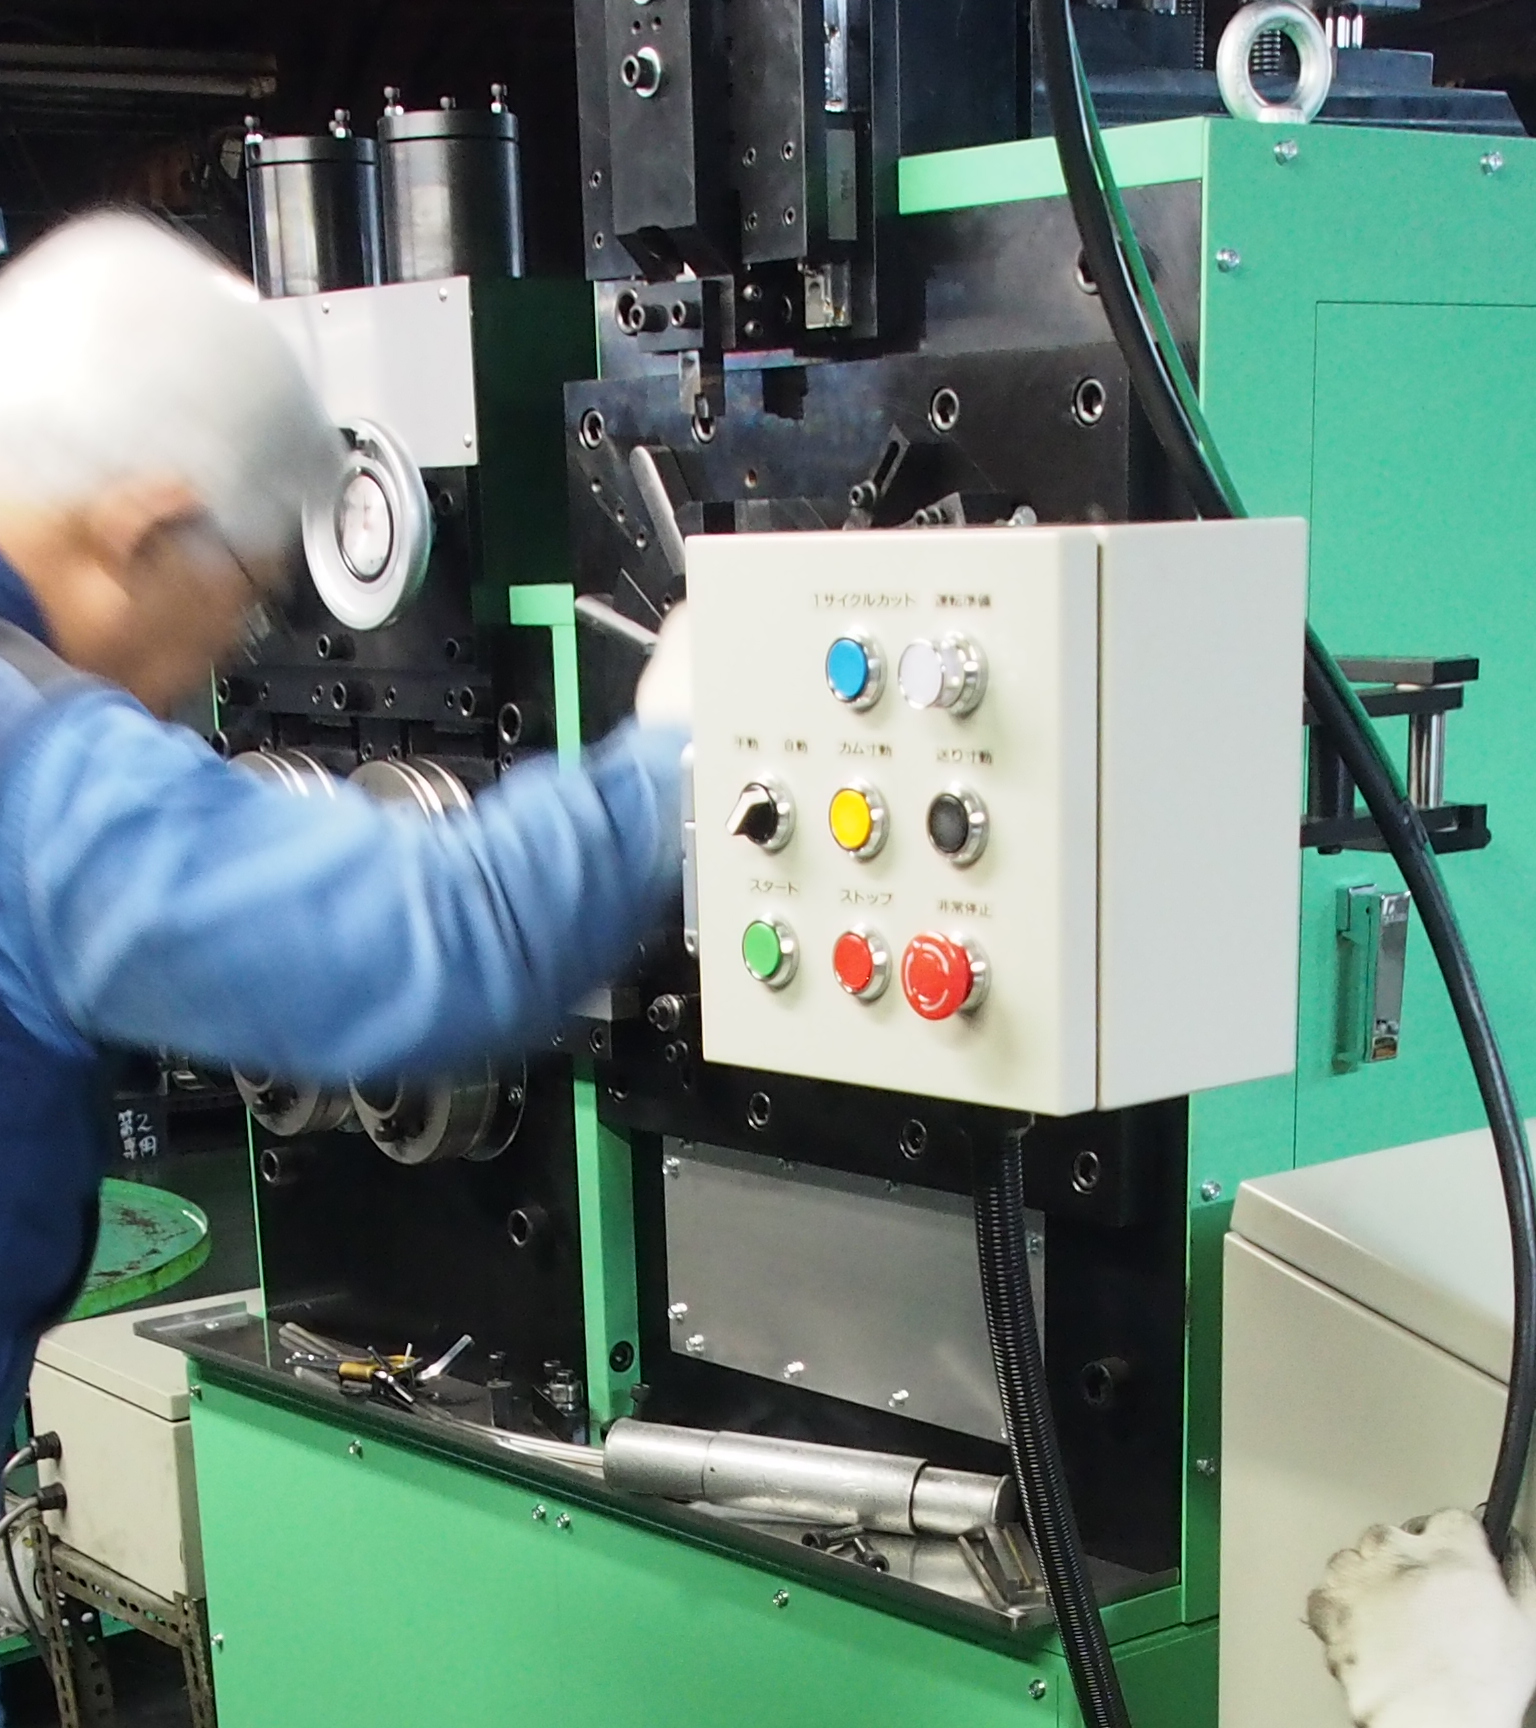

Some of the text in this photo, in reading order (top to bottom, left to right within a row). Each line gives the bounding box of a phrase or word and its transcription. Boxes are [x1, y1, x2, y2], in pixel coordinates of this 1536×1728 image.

[815, 594, 915, 607] 1サイクルカット
[785, 738, 807, 753] 自動
[751, 880, 992, 917] スタート ストップ 非常停止
